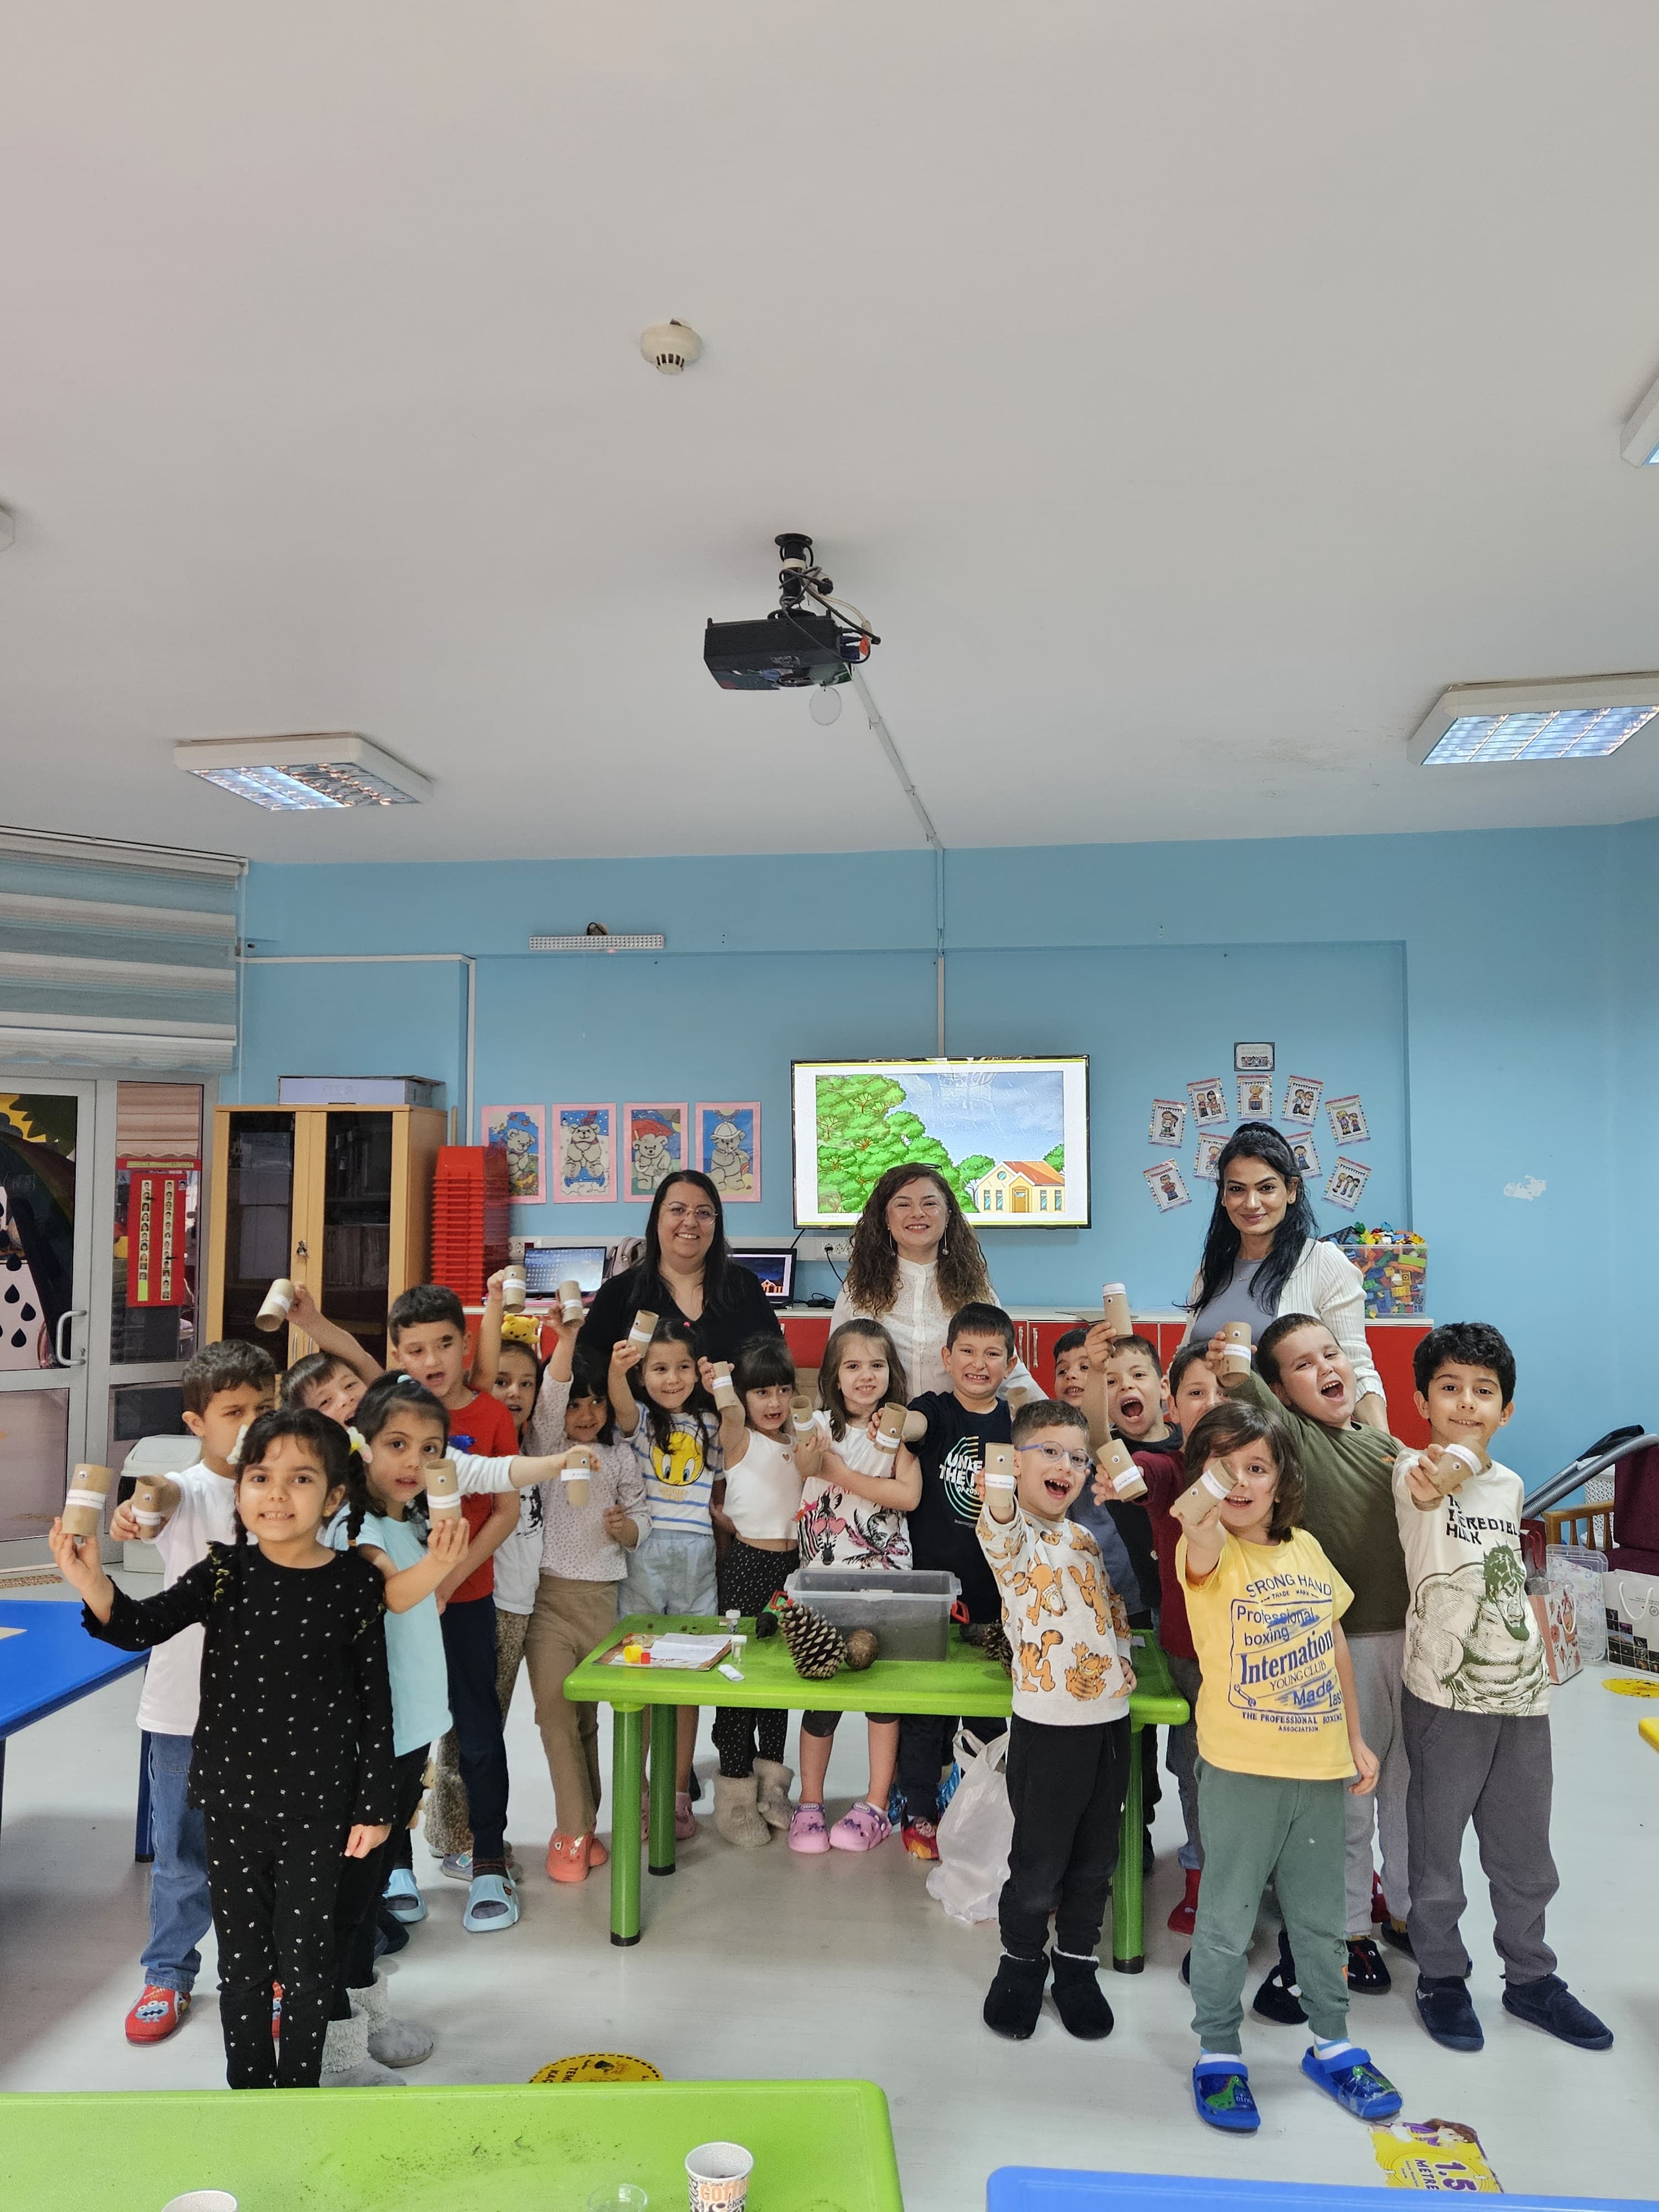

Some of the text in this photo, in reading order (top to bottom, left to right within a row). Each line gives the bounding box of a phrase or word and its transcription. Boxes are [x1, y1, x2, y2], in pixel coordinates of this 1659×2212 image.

[939, 1464, 966, 1486] THE
[1246, 1573, 1332, 1598] SRONG HAND
[1272, 1590, 1290, 1600] TRADE
[1244, 1626, 1290, 1646] boxing
[1270, 1660, 1327, 1691] YOUNG CLUB
[1293, 1679, 1334, 1705] Made
[1242, 1712, 1258, 1720] THE
[1260, 1714, 1318, 1724] PROFESSIONAL
[1413, 2159, 1440, 2190] METRE
